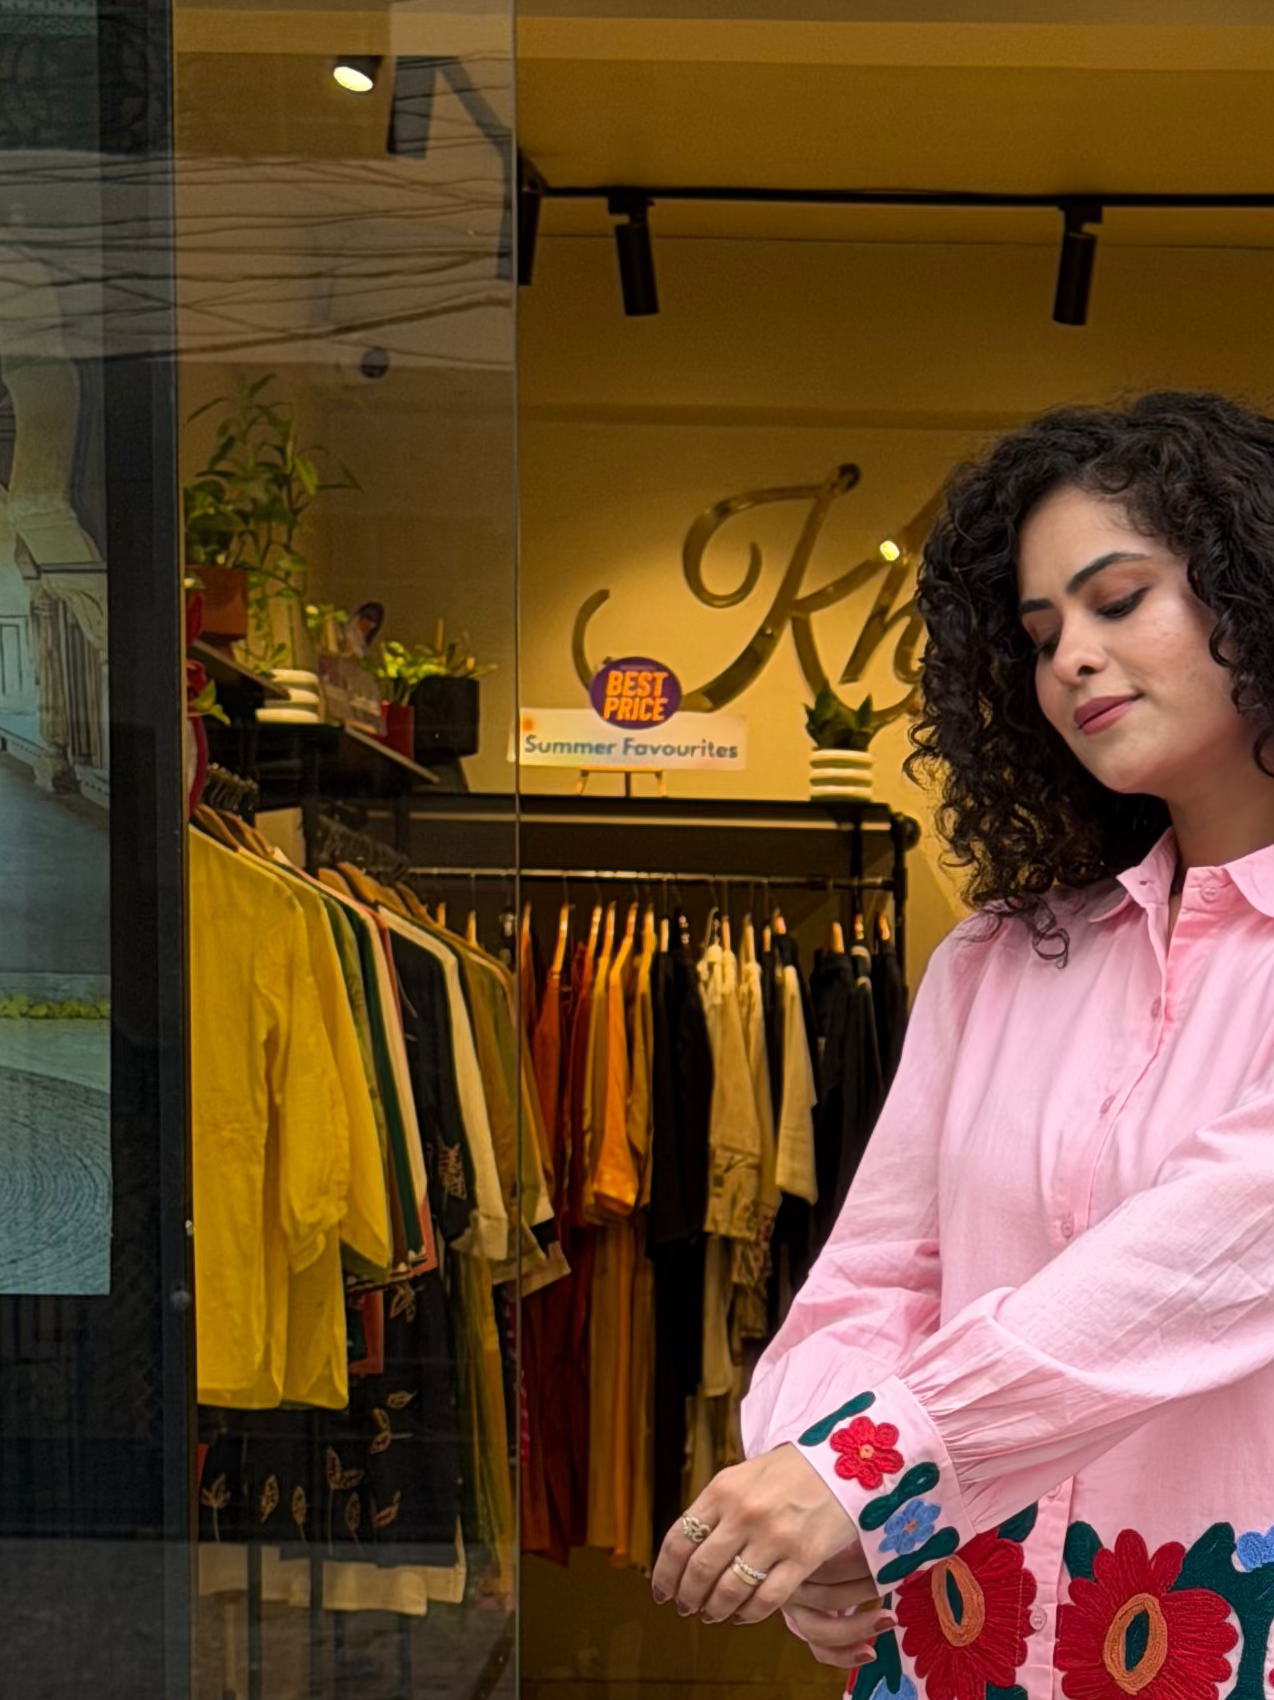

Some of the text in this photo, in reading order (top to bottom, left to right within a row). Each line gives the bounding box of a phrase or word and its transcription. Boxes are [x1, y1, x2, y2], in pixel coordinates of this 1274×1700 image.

[605, 670, 669, 697] BEST
[602, 697, 668, 722] PRICE
[524, 734, 739, 759] Summer Favourites
